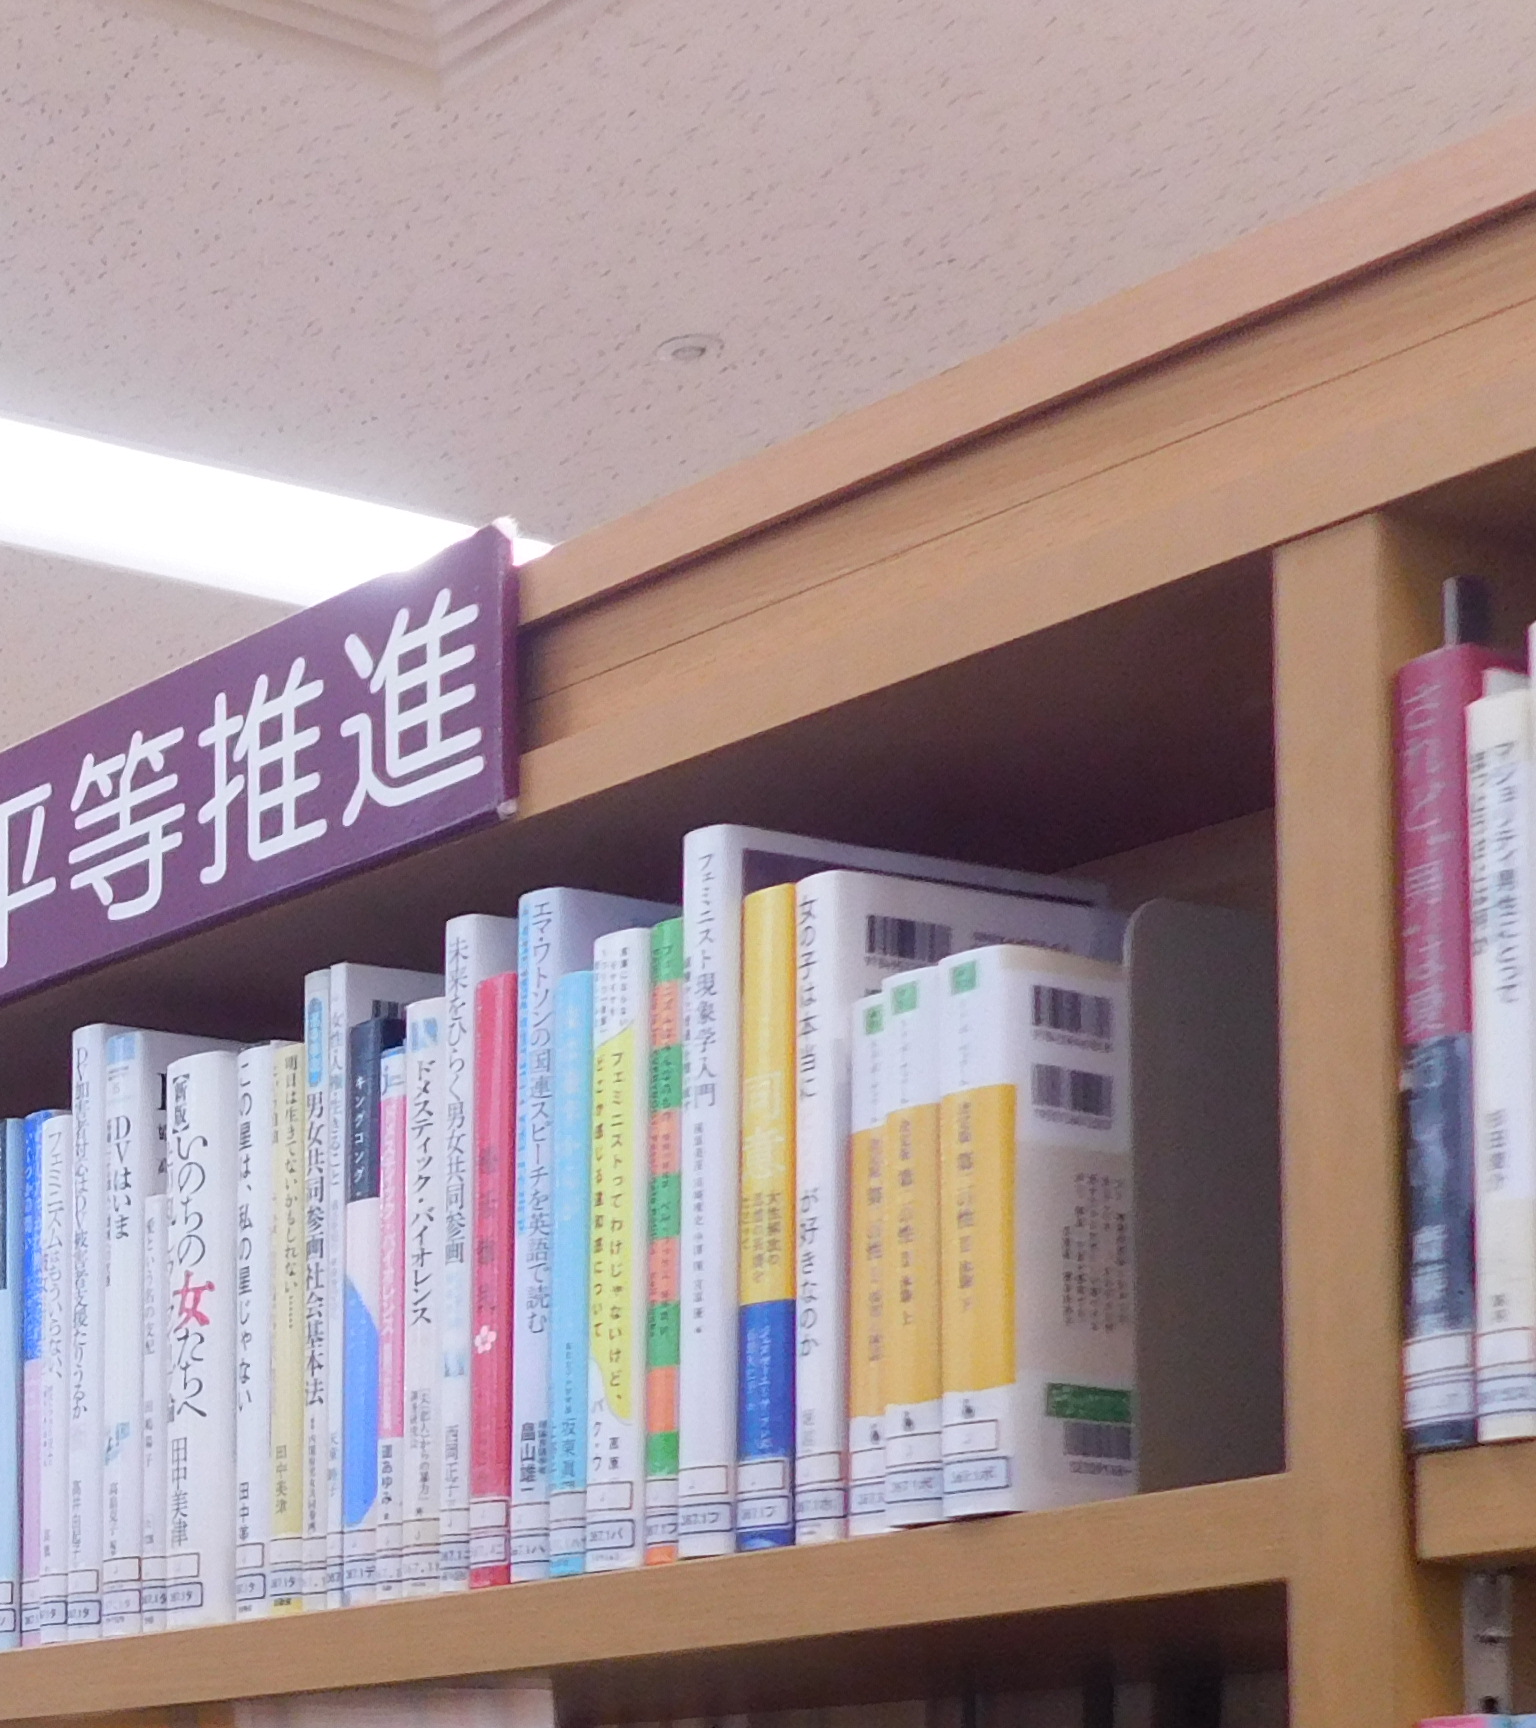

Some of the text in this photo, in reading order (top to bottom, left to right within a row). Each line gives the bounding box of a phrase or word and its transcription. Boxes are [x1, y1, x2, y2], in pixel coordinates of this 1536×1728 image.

[444, 935, 469, 1267] 未来をひらく男女共同参画
[694, 851, 718, 1109] フェミニスト現象学入門
[112, 1115, 132, 1240] DVはいま
[236, 1059, 253, 1414] この星は、私の星じゃない
[413, 1057, 436, 1328] ドメスティック・バイオレンス
[526, 898, 553, 1333] エマ・ワトソンの国連スピーチを英語で読む
[609, 1048, 627, 1404] フェミニストってわけじゃないけど、
[742, 1076, 788, 1180] 同意
[145, 1215, 157, 1356] 愛という名の支配
[304, 1090, 326, 1407] 男女共同参画社会基本法
[169, 1434, 190, 1549] 田中美津
[274, 1443, 289, 1515] 田中美津
